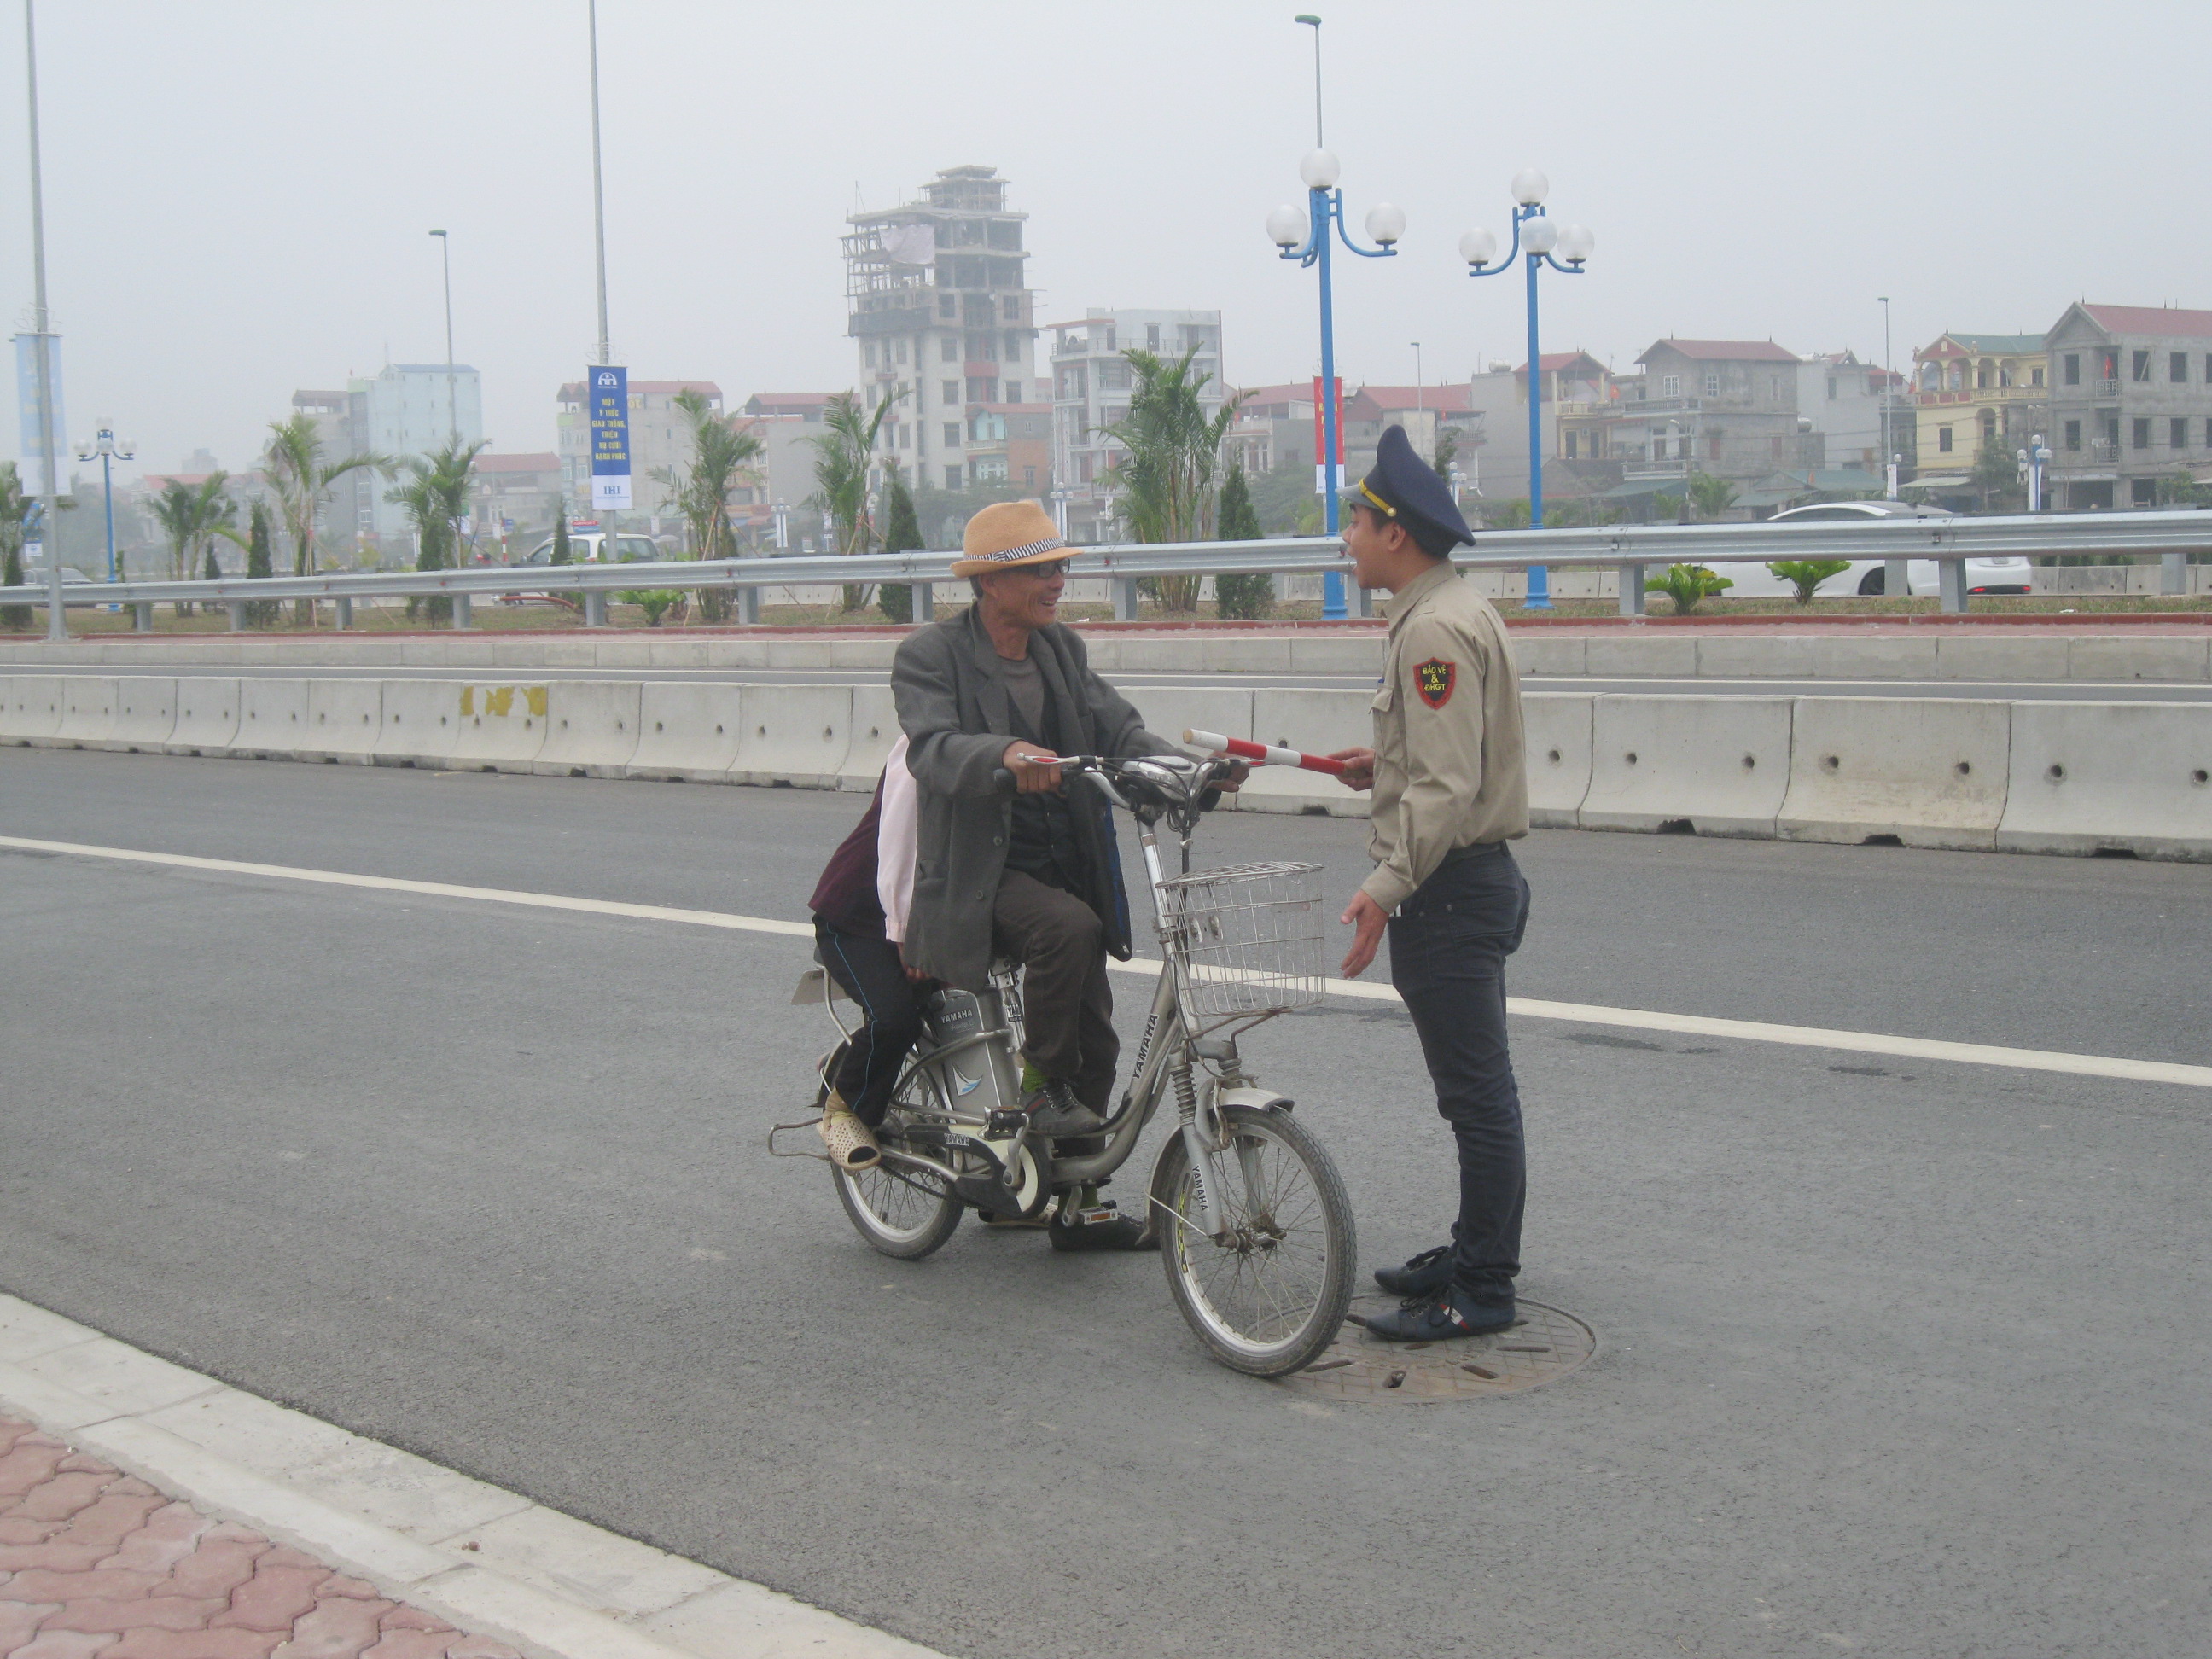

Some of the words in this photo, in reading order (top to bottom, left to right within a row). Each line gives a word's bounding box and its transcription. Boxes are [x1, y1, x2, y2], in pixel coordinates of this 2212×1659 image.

[603, 486, 620, 495] IHI
[1423, 664, 1436, 674] BẢO
[1437, 664, 1447, 674] VỆ
[1431, 674, 1439, 683] &
[941, 1009, 973, 1024] YAMAHA
[1133, 1014, 1159, 1080] YAMAHA
[944, 1132, 970, 1146] YAMAHA
[1192, 1165, 1208, 1212] YAMAHA
